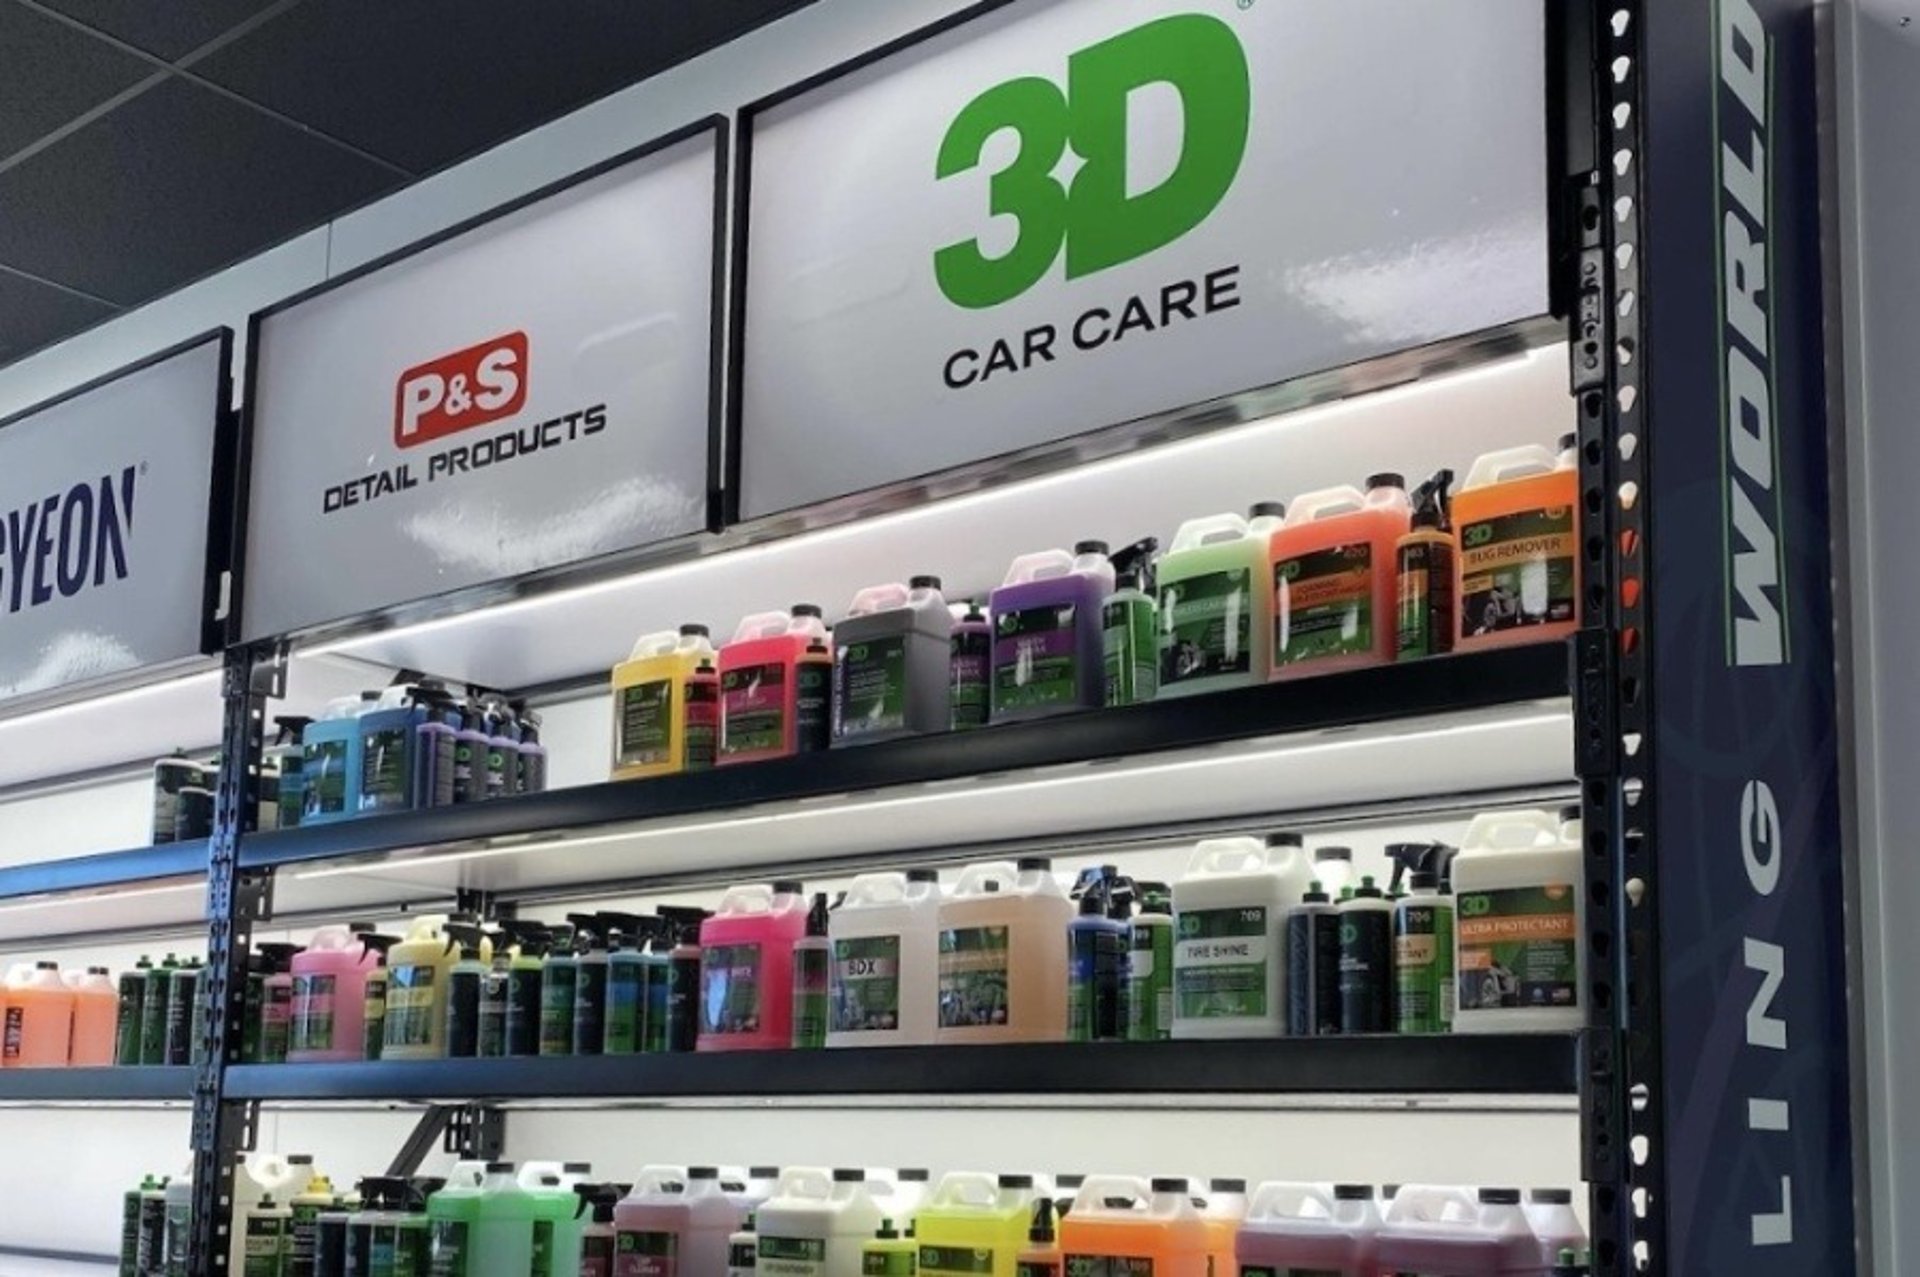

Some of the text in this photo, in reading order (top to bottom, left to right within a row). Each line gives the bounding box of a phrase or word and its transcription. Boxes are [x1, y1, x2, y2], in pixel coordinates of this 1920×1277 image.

[934, 13, 1250, 309] 3D
[943, 265, 1241, 389] CAR CARE
[1719, 0, 1783, 666] WORLD
[402, 347, 519, 436] P&S
[323, 403, 607, 514] DETAIL PRODUCTS
[0, 465, 136, 613] YEON
[1469, 538, 1561, 564] BUG REMOVER
[1461, 896, 1490, 915] 3D
